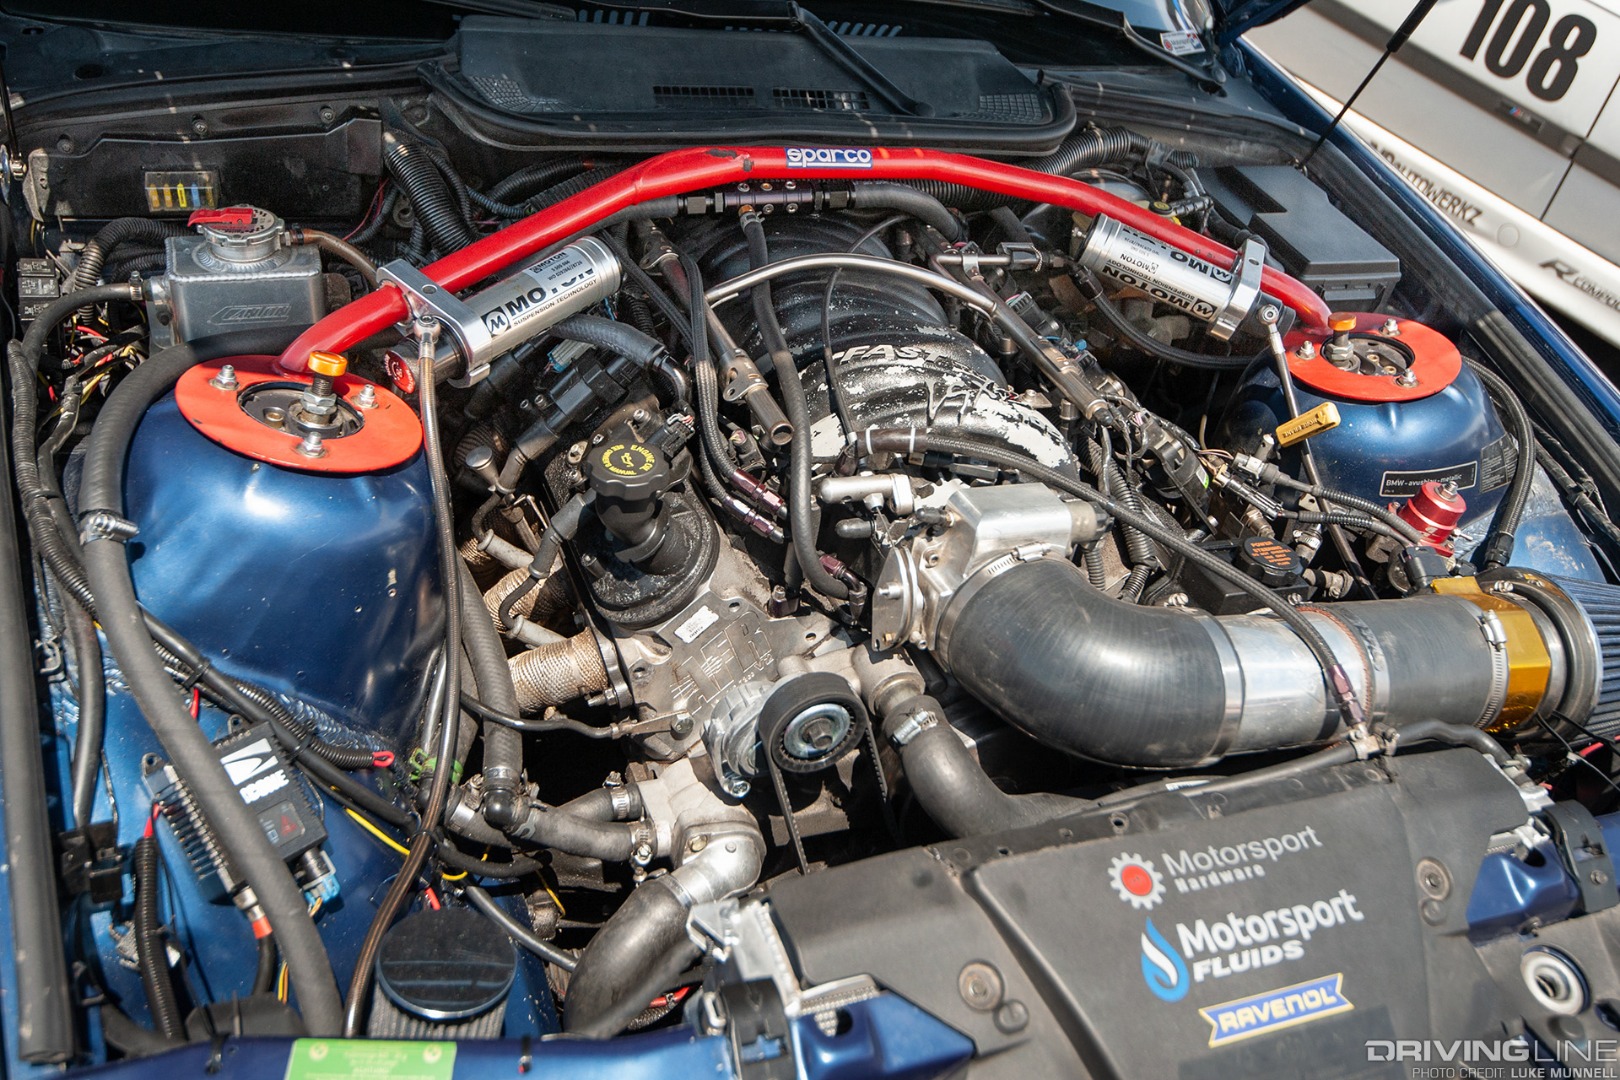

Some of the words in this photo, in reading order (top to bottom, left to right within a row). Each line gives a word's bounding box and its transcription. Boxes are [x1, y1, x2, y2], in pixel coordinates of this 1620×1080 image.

[1459, 0, 1597, 102] 108
[787, 148, 871, 168] sparco
[1106, 259, 1152, 284] TECHNOLOGY
[1120, 253, 1152, 272] MOTON
[513, 301, 555, 327] SUSPENSION
[556, 278, 598, 306] TECHNOLOGY
[1102, 265, 1192, 309] MOTON
[1153, 277, 1195, 300] SUSPENSION
[840, 344, 948, 364] FAST
[1385, 479, 1405, 487] BMW
[1161, 825, 1323, 877] Motorsport
[1173, 864, 1266, 894] Hardware
[1176, 888, 1365, 959] Motorsport
[1193, 939, 1305, 983] FLUIDS
[1218, 987, 1338, 1033] RAVENOL
